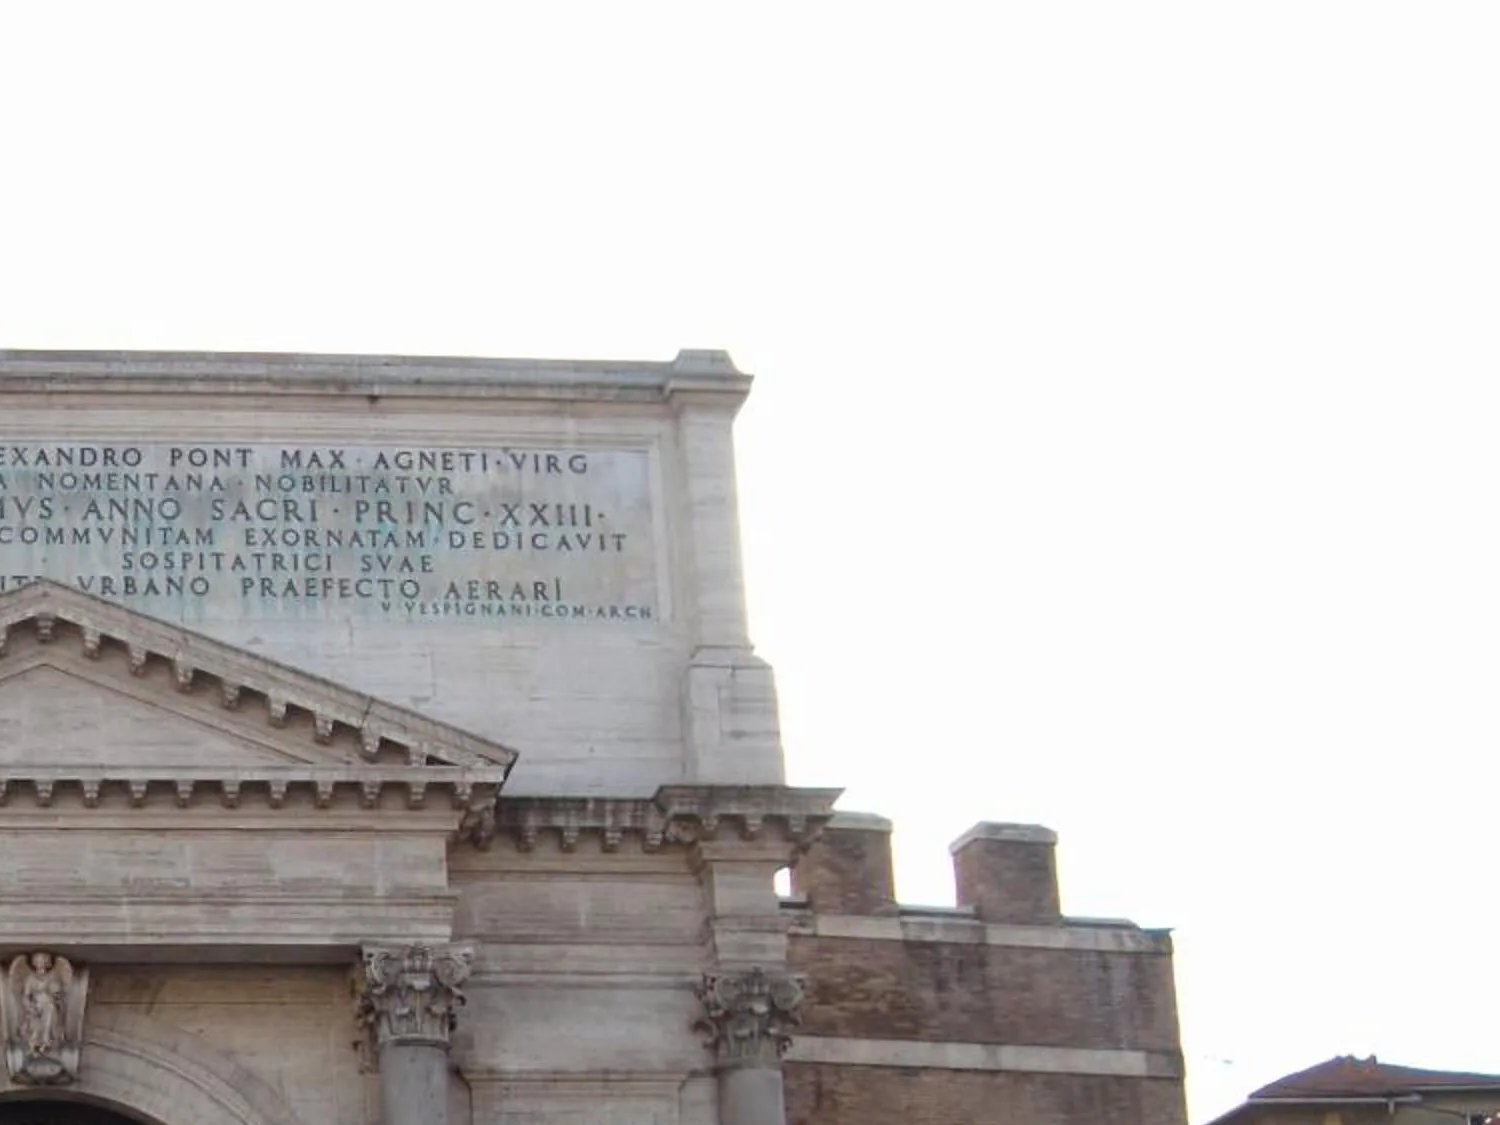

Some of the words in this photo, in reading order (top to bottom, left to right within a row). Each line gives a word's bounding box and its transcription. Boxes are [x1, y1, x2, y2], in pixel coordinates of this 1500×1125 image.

[170, 448, 254, 468] PONT
[281, 449, 346, 469] MAX
[373, 451, 488, 473] AGNETI
[510, 453, 588, 475] VIRG
[38, 472, 227, 491] NOMENTANA
[255, 474, 454, 496] NOBILITATVR
[82, 498, 182, 522] ANNO
[211, 499, 319, 523] SACRI
[355, 500, 475, 525] PRINC
[245, 527, 425, 549] EXORNATAM
[448, 531, 628, 552] DEDICAVIT
[122, 552, 333, 572] SOSPITATRICI
[360, 554, 434, 574] SVAE
[77, 575, 210, 597] VRBANO
[241, 576, 421, 599] PRAEFECTO
